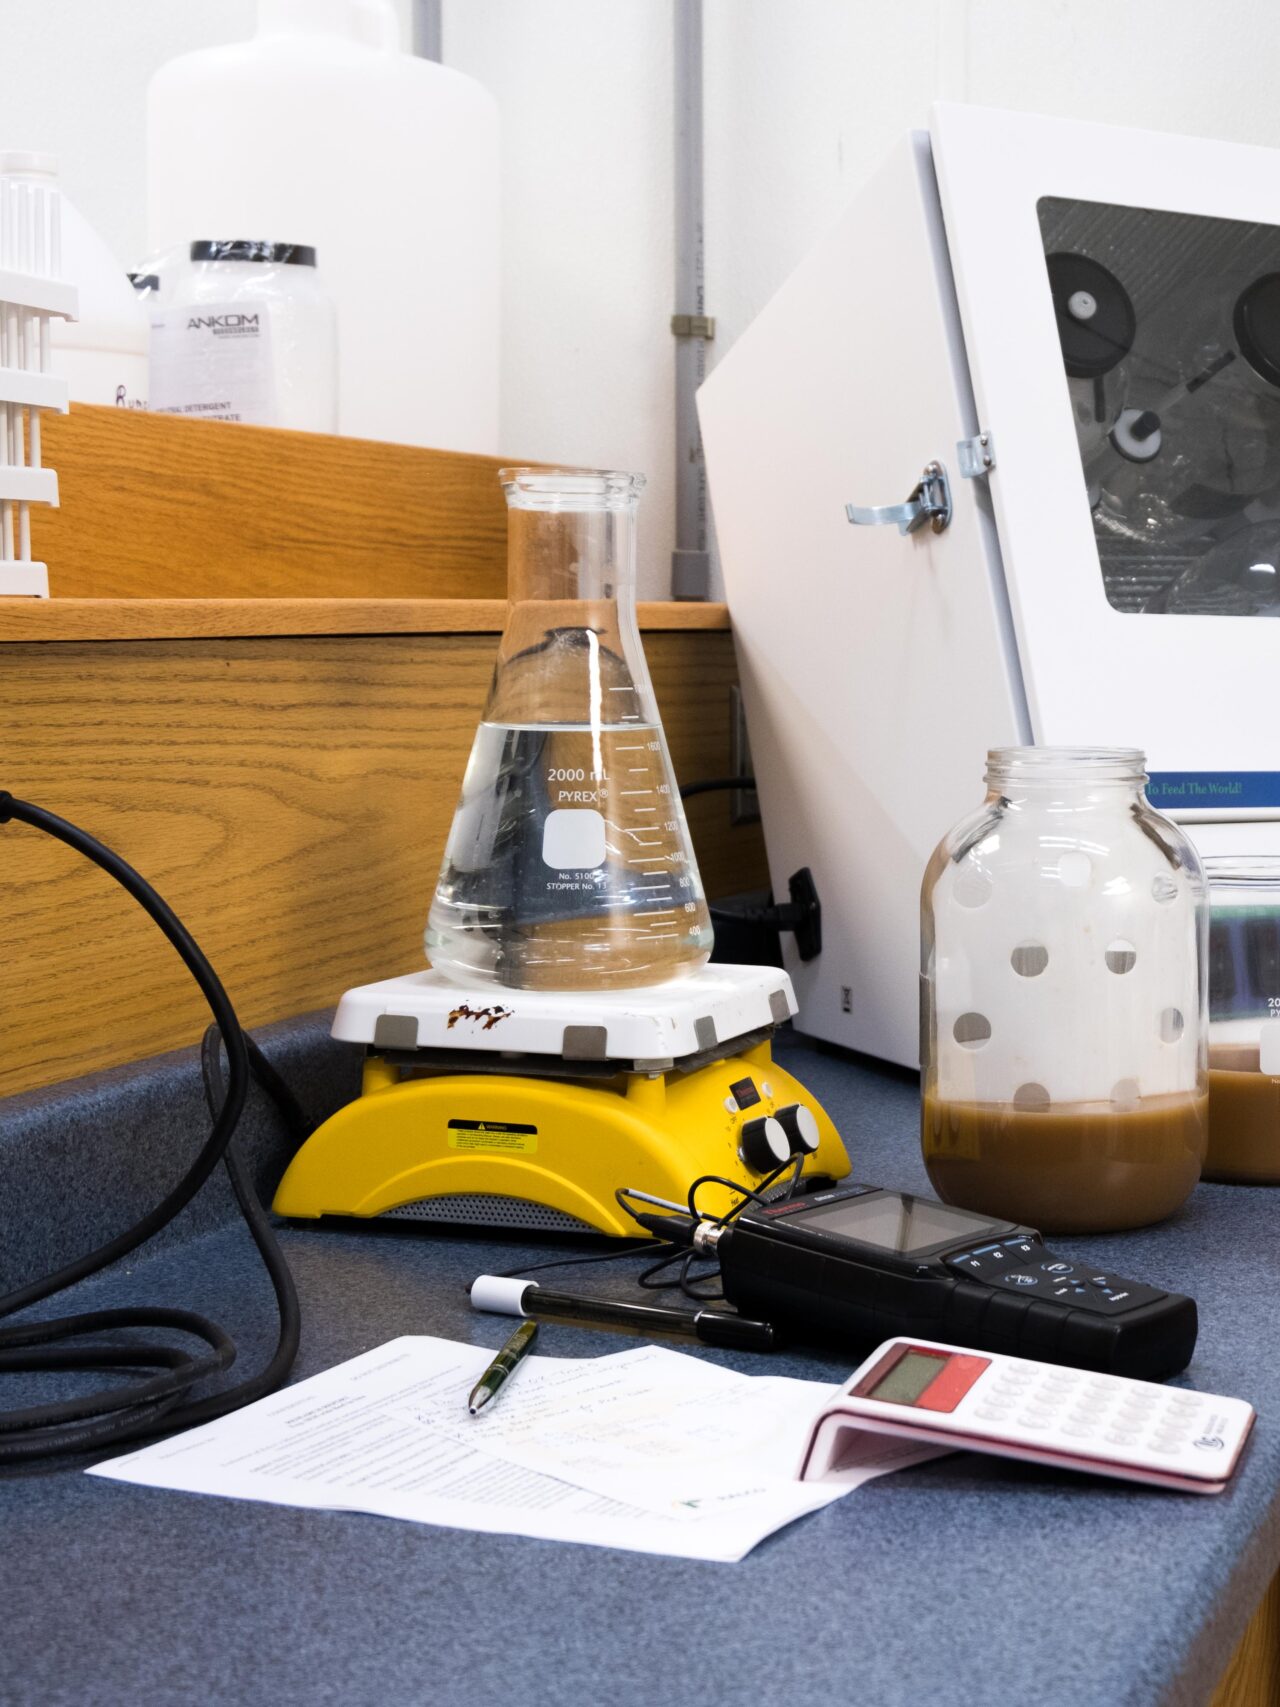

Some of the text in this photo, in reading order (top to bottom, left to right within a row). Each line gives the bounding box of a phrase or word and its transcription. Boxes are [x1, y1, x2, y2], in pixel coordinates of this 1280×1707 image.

[187, 313, 260, 330] ANKOM
[547, 768, 585, 781] 2000
[1162, 783, 1185, 795] Feed
[1187, 782, 1207, 795] The
[1207, 782, 1243, 795] World!
[546, 882, 580, 890] STOPPER
[680, 877, 690, 888] 800
[684, 902, 696, 913] 600
[689, 925, 701, 936] 400
